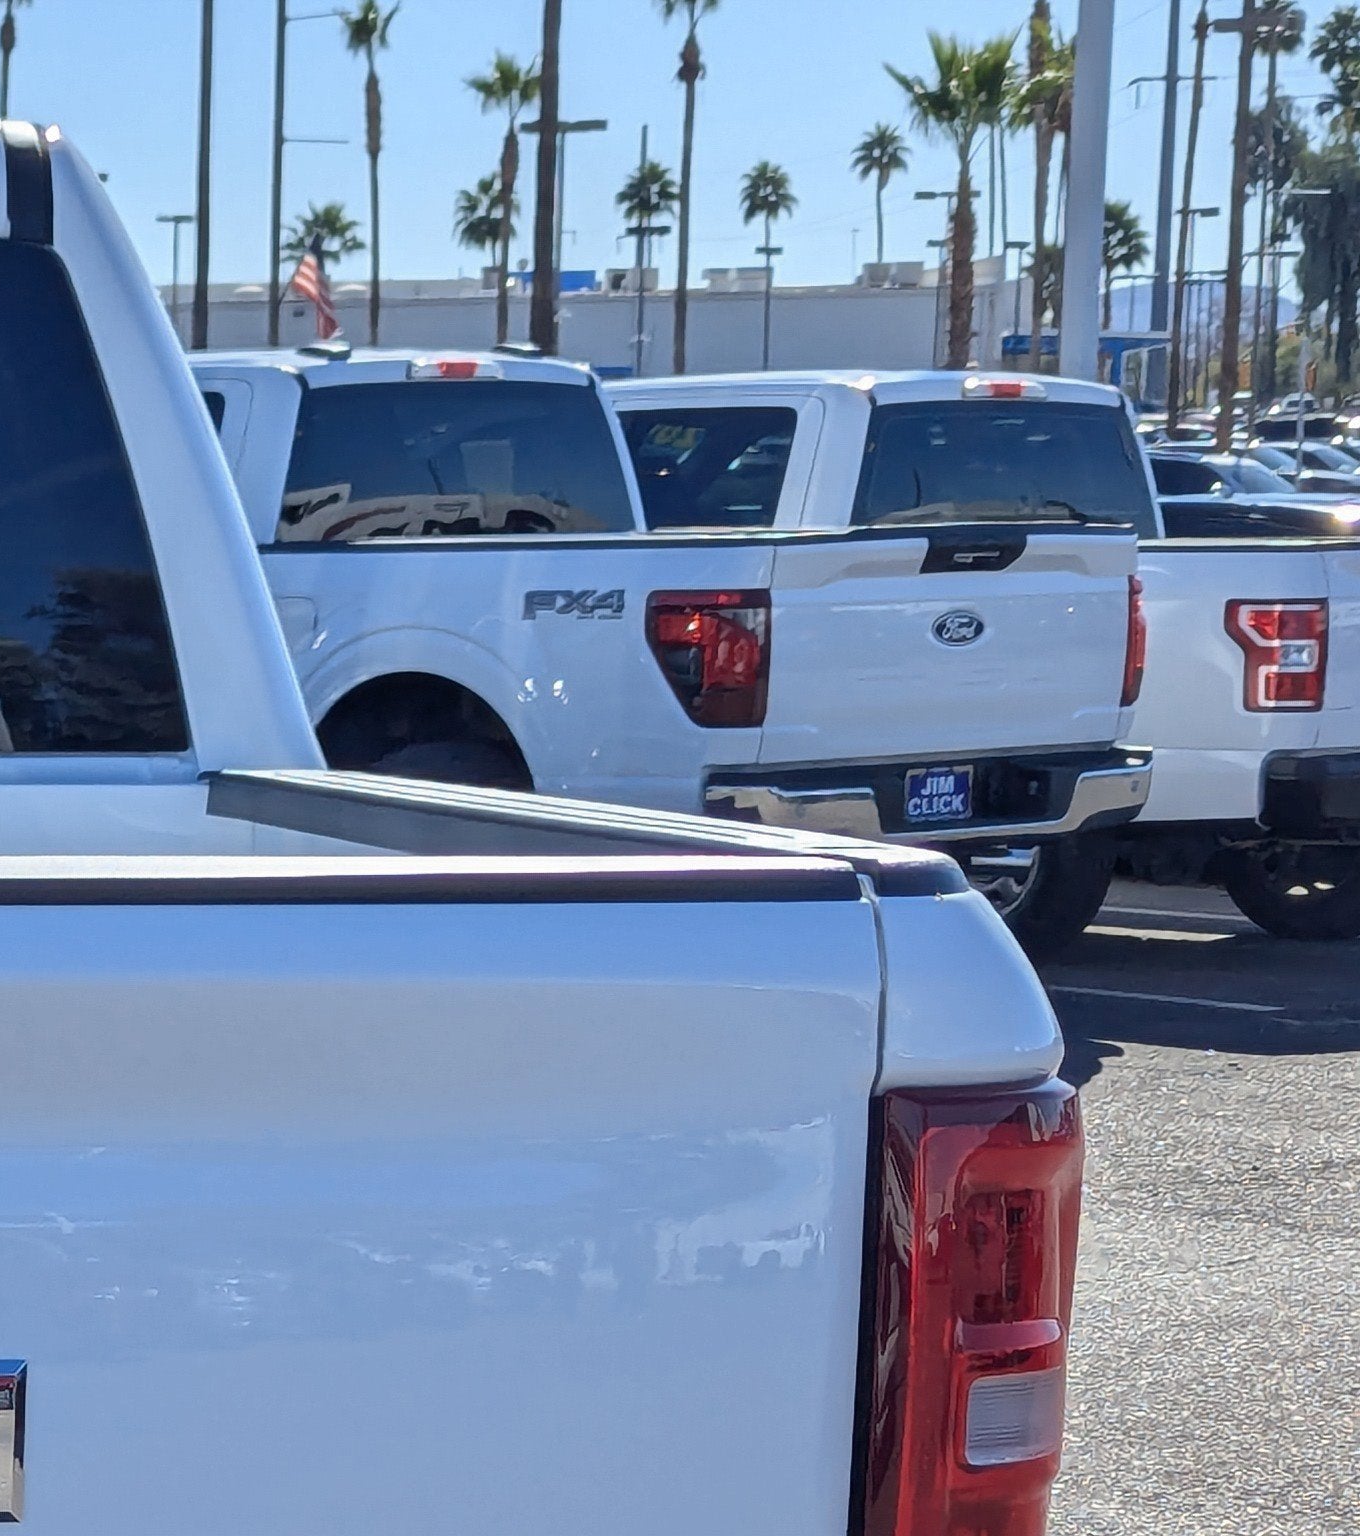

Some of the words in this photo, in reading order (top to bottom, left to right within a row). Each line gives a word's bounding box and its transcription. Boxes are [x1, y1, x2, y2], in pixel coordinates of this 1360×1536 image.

[521, 589, 625, 620] FX4
[941, 617, 978, 639] Ford
[920, 775, 955, 796] JIM
[907, 793, 965, 816] CLICK
